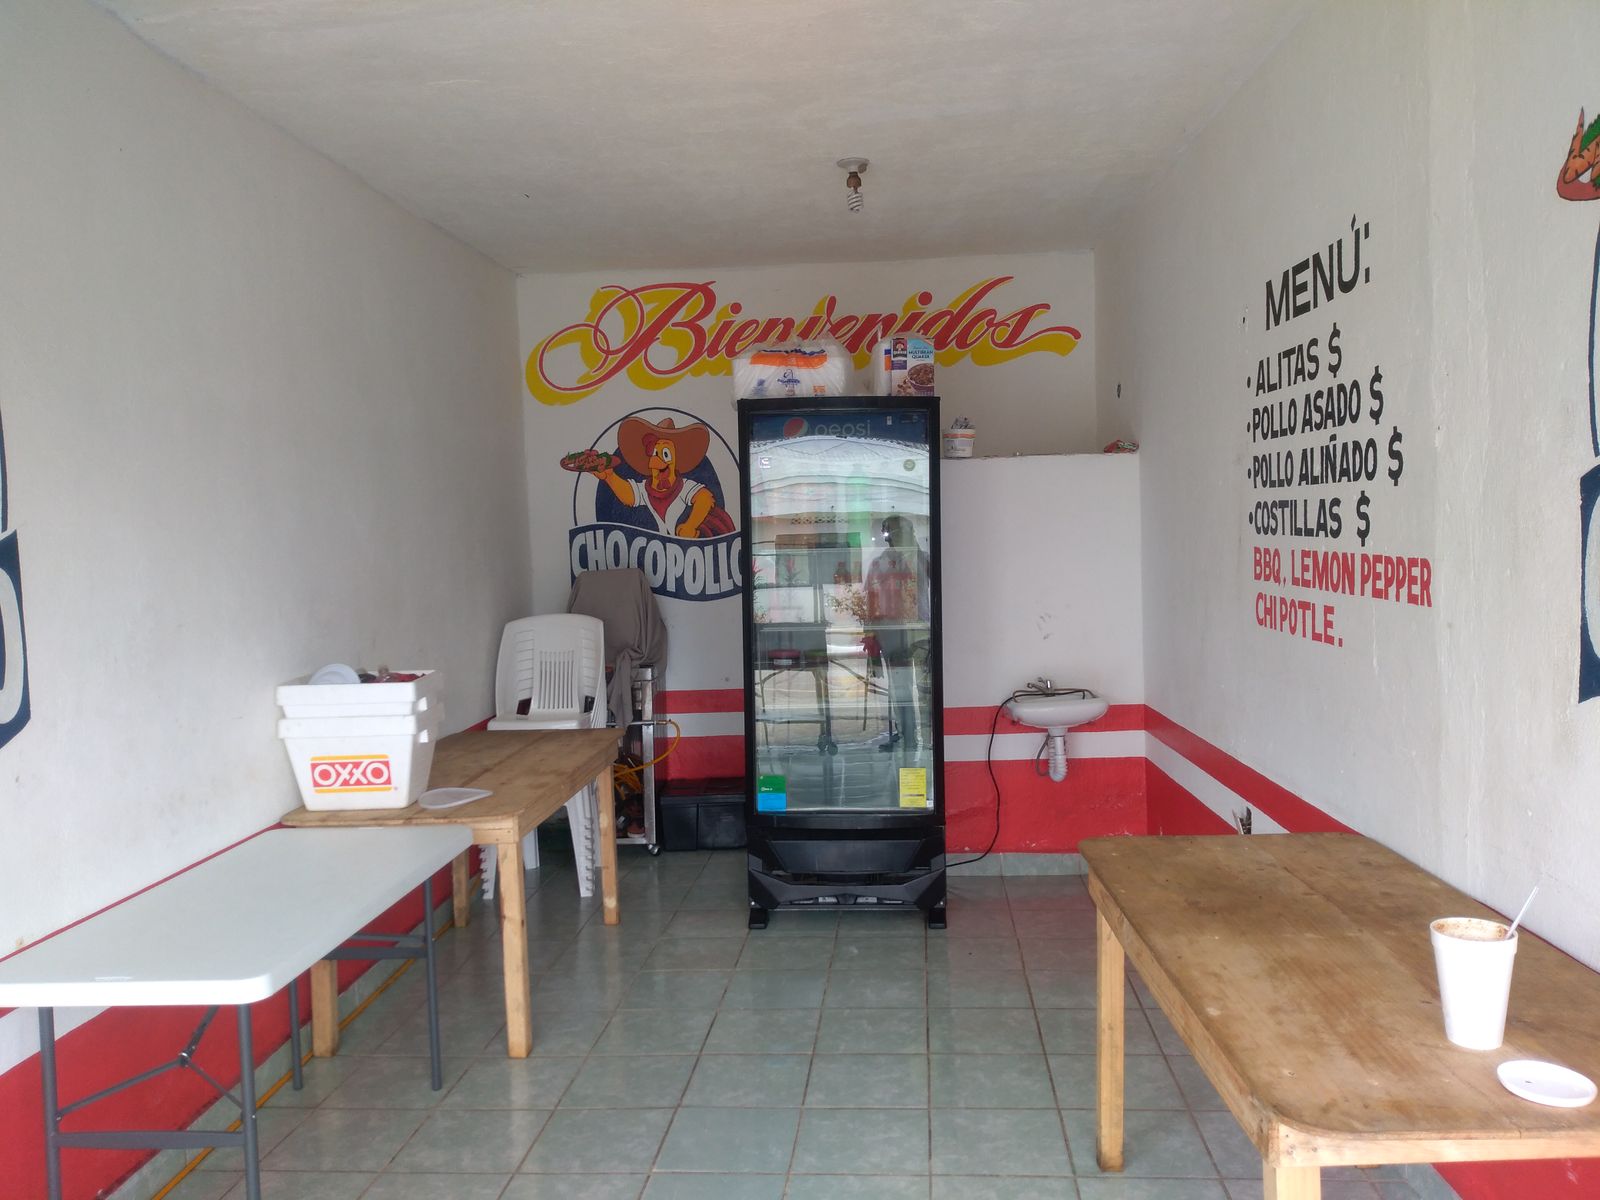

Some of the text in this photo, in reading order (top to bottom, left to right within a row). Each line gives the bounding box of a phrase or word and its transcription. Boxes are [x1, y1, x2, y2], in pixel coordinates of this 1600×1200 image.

[1265, 213, 1370, 331] MENÚ:
[1255, 337, 1320, 397] ALITAS
[1252, 398, 1297, 443] POLLO
[1301, 379, 1361, 434] ASADO
[1253, 450, 1294, 489] POLLO
[1298, 433, 1378, 486] ALIÑADO
[1254, 497, 1342, 539] COSTILLAS
[1291, 549, 1355, 596] LEMON
[1360, 553, 1433, 608] PEPPER
[313, 759, 389, 788] OXXO
